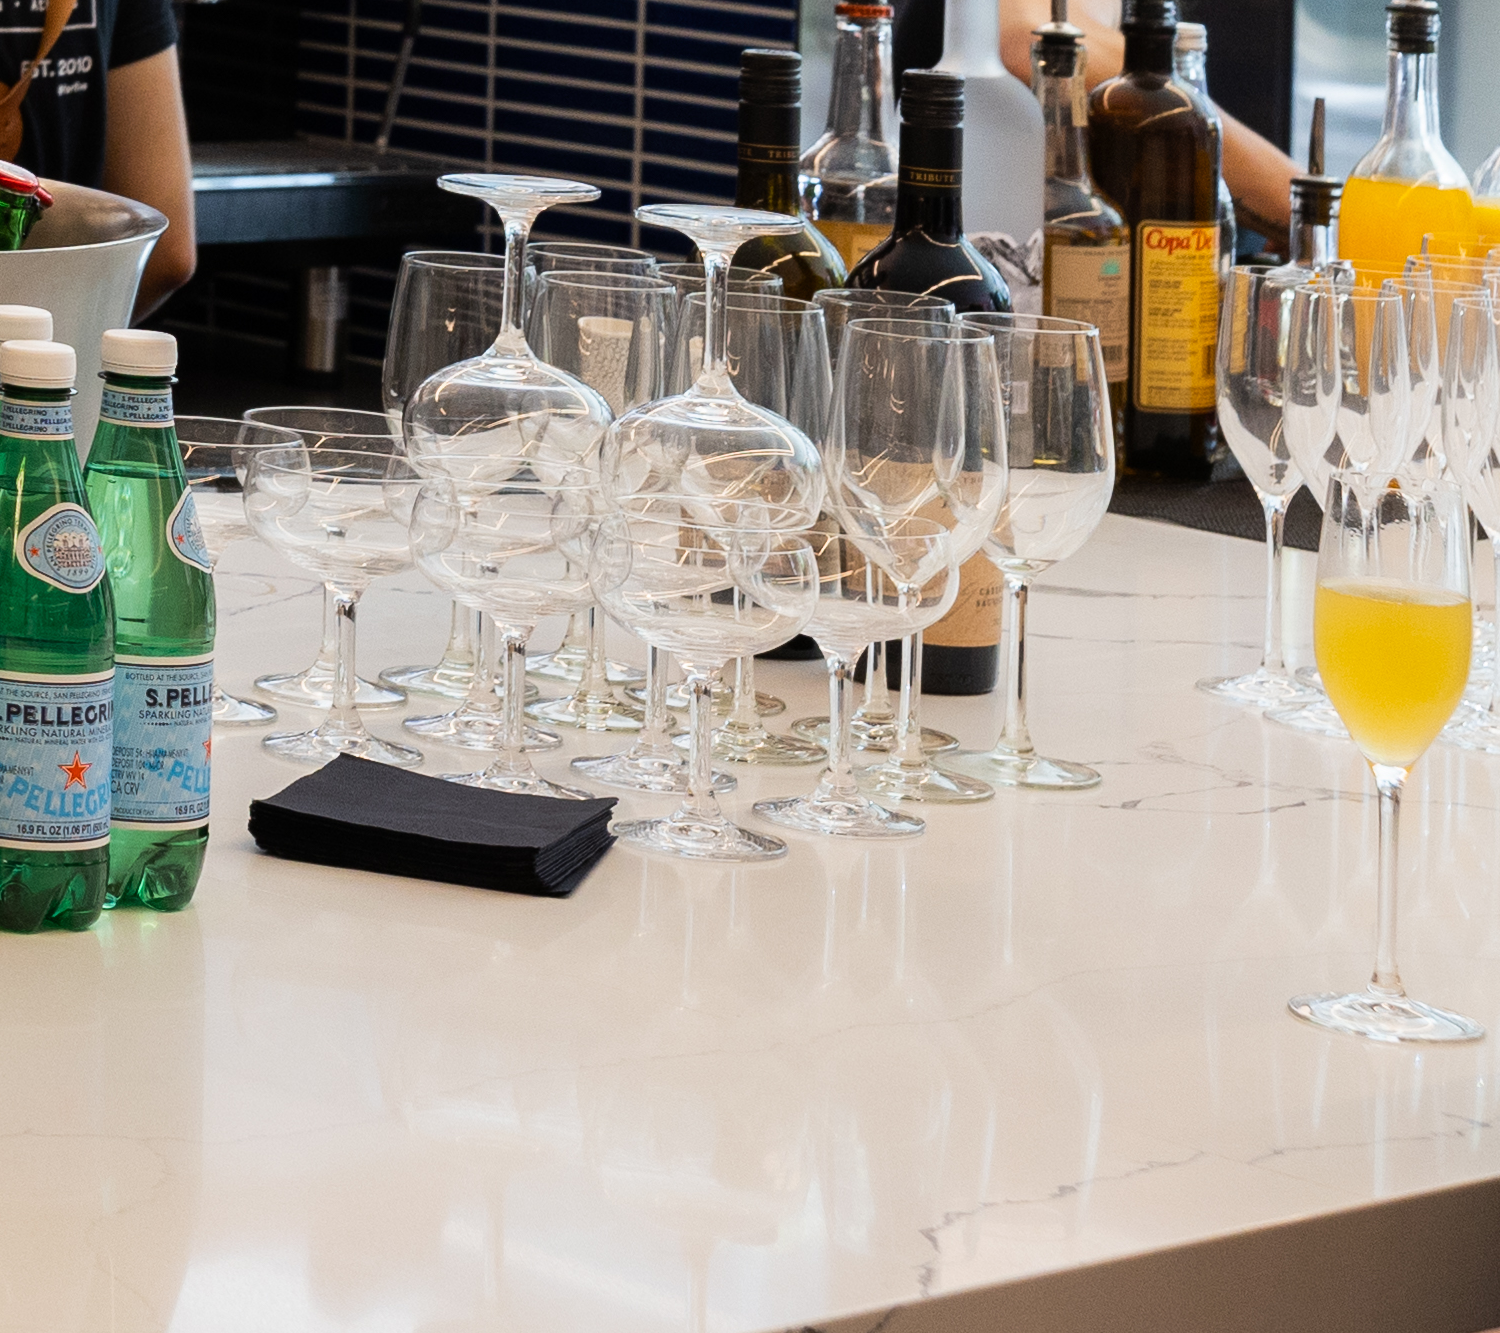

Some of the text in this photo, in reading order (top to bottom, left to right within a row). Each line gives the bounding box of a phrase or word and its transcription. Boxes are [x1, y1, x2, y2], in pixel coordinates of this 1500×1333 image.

[57, 56, 93, 77] 2010
[909, 171, 957, 183] TRIBUTE
[1145, 227, 1191, 255] Copa
[41, 726, 86, 739] NATURAL
